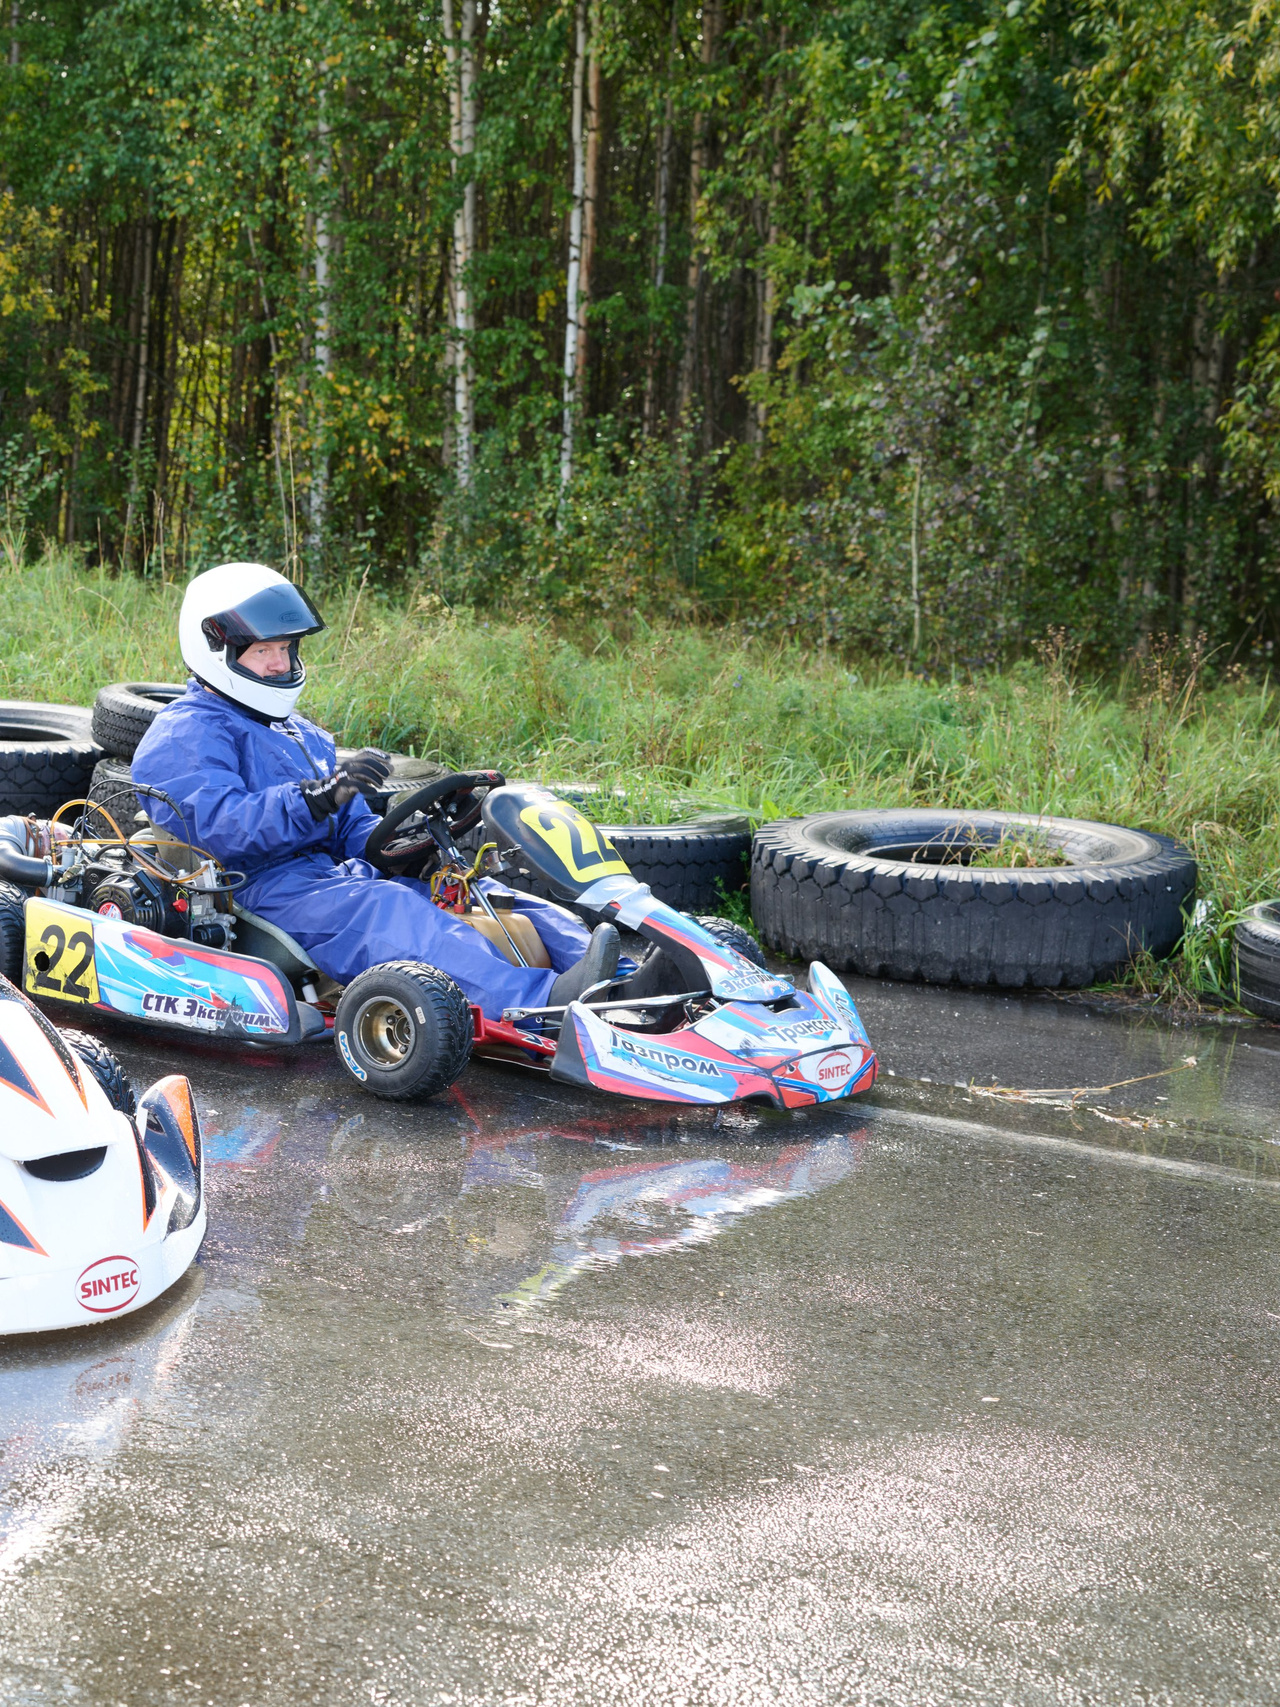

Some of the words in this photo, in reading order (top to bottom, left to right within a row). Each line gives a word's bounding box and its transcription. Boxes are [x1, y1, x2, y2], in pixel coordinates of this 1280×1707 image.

[538, 806, 623, 871] 22
[35, 924, 95, 999] 22
[143, 993, 179, 1014] СТК
[767, 1019, 843, 1044] Трансгаз
[611, 1030, 720, 1077] Газпром
[818, 1063, 851, 1081] SINTEC
[80, 1268, 139, 1300] SINTEC
